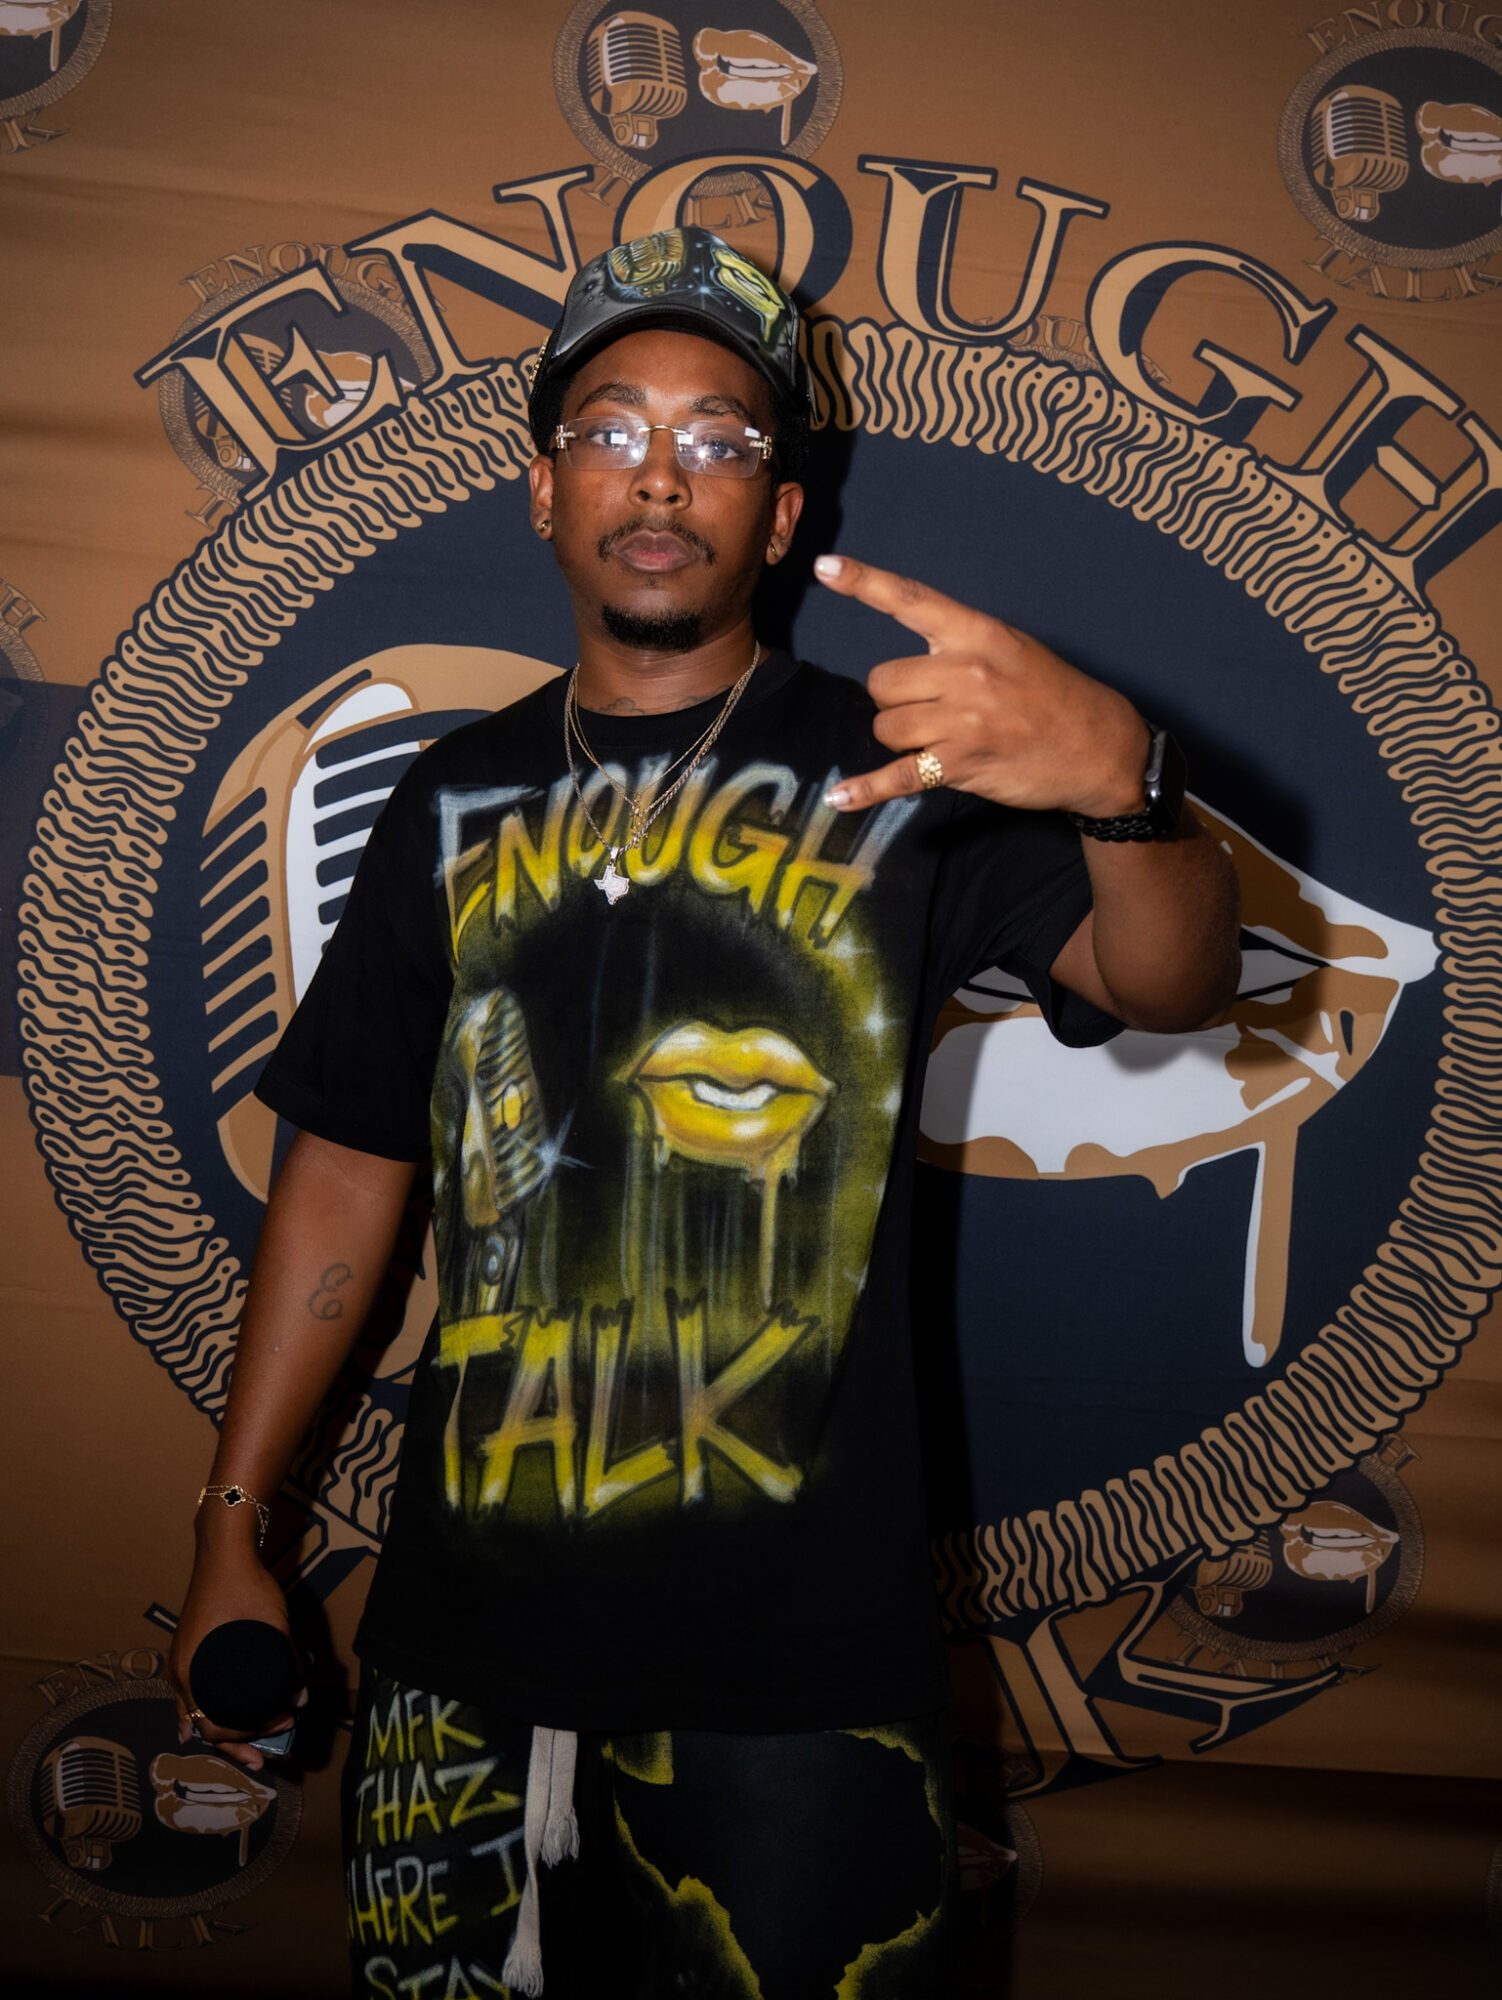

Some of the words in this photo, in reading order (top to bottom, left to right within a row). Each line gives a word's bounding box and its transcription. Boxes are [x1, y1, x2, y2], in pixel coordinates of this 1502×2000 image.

[178, 242, 447, 312] ENOUG
[135, 150, 1502, 616] ENOUGH
[433, 752, 922, 966] ENOUGH
[432, 1289, 822, 1533] TALK
[365, 1687, 486, 1769] MFK
[355, 1752, 522, 1846] THAZ
[347, 1852, 460, 1947] HERE
